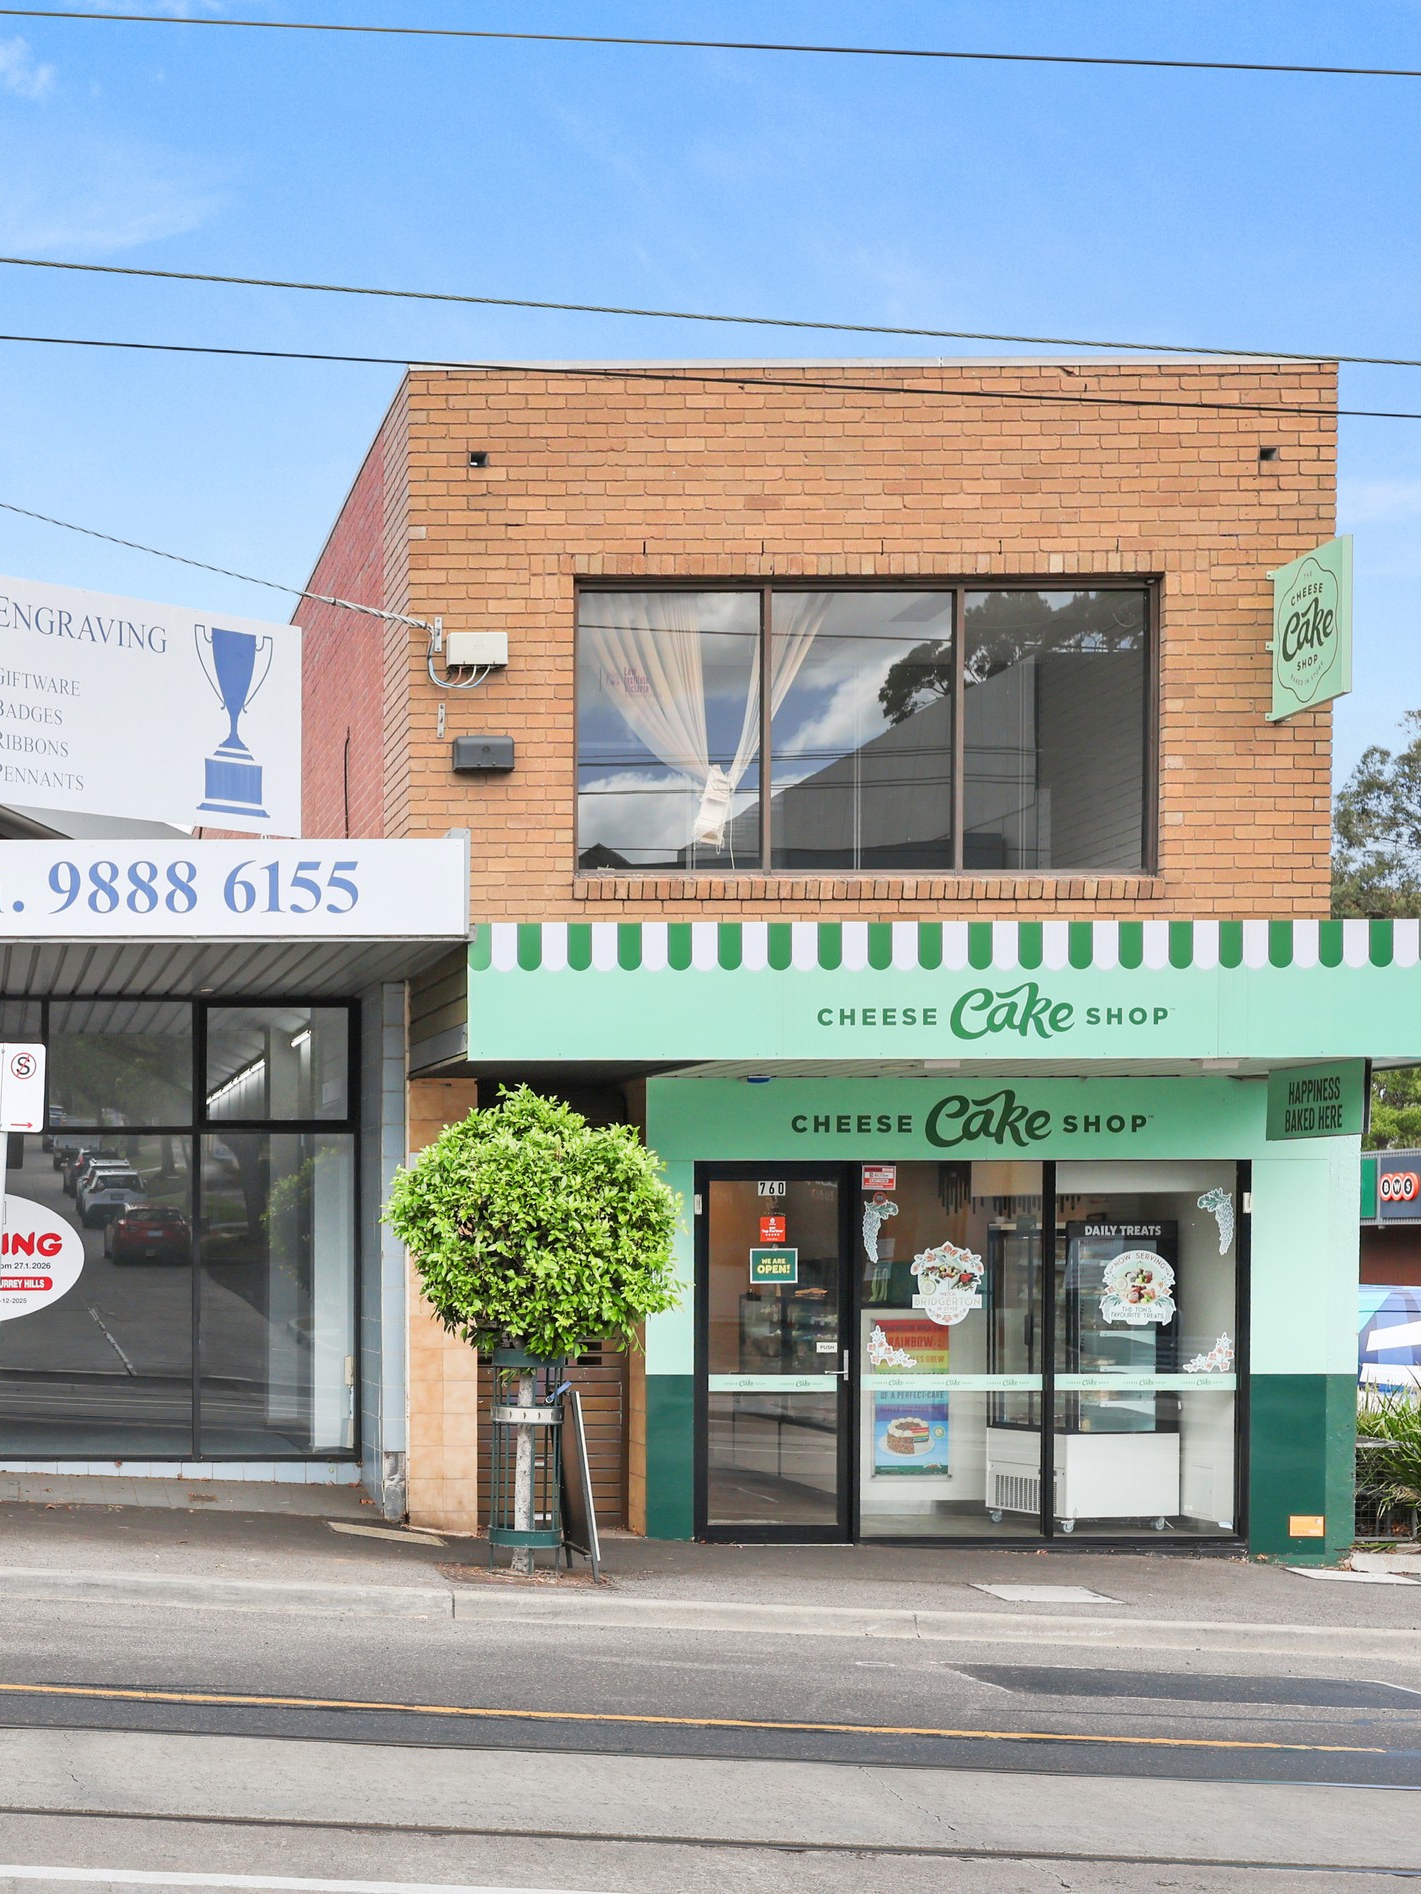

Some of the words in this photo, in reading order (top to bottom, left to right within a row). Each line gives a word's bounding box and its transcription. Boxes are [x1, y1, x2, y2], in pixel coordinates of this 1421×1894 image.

[1290, 582, 1324, 607] CHEESE
[1282, 596, 1334, 663] Cake
[1296, 654, 1319, 672] SHOP
[48, 859, 198, 915] 9888
[223, 859, 360, 914] 6155
[817, 1007, 938, 1026] CHEESE
[950, 981, 1075, 1041] Cake
[1085, 1006, 1169, 1026] SHOP
[16, 1056, 31, 1076] S
[1288, 1076, 1341, 1106] HAPPINESS
[791, 1115, 913, 1134] CHEESE
[925, 1089, 1052, 1148] Cake
[1062, 1115, 1148, 1134] SHOP
[1284, 1106, 1315, 1133] BAKED
[1318, 1104, 1343, 1130] HERE
[759, 1182, 785, 1195] 760
[1382, 1178, 1413, 1196] BWS
[1084, 1225, 1117, 1236] DAILY
[1119, 1225, 1162, 1236] TREATS
[14, 1262, 51, 1270] 27.1.2026
[756, 1265, 791, 1274] OPEN!
[1113, 1254, 1131, 1268] NOW
[1135, 1252, 1167, 1269] SERVING
[0, 1279, 22, 1289] URREY
[24, 1279, 45, 1289] HILLS
[914, 1297, 981, 1306] BRIDGERTON
